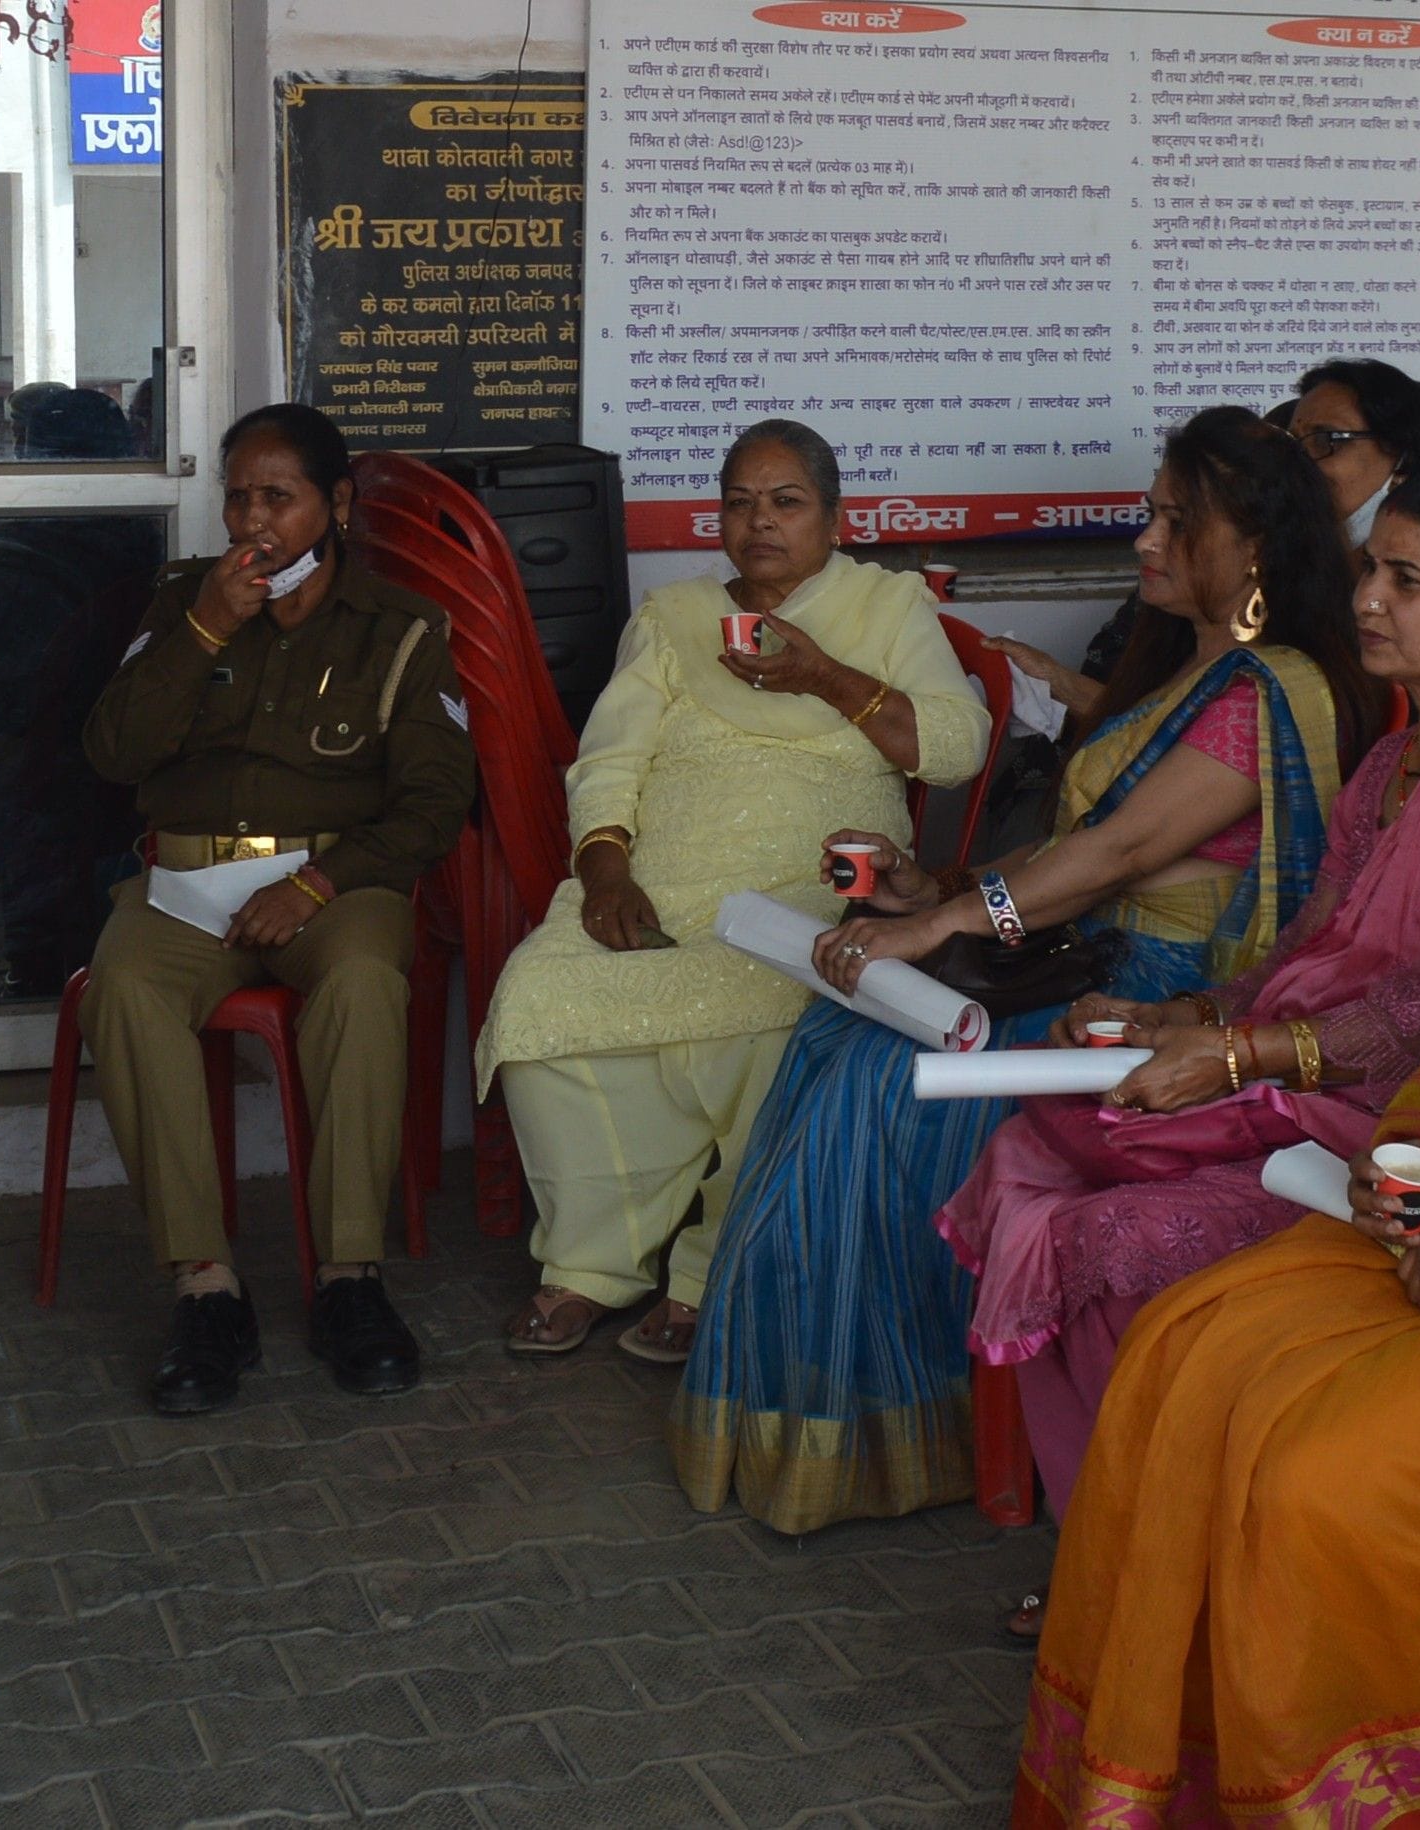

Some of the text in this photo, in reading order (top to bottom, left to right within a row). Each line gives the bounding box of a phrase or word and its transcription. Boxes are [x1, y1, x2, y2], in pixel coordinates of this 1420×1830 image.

[821, 8, 903, 29] क्या करें
[1317, 25, 1412, 45] क्या न करें
[430, 106, 536, 126] विवेचना
[846, 499, 969, 543] पुलिस
